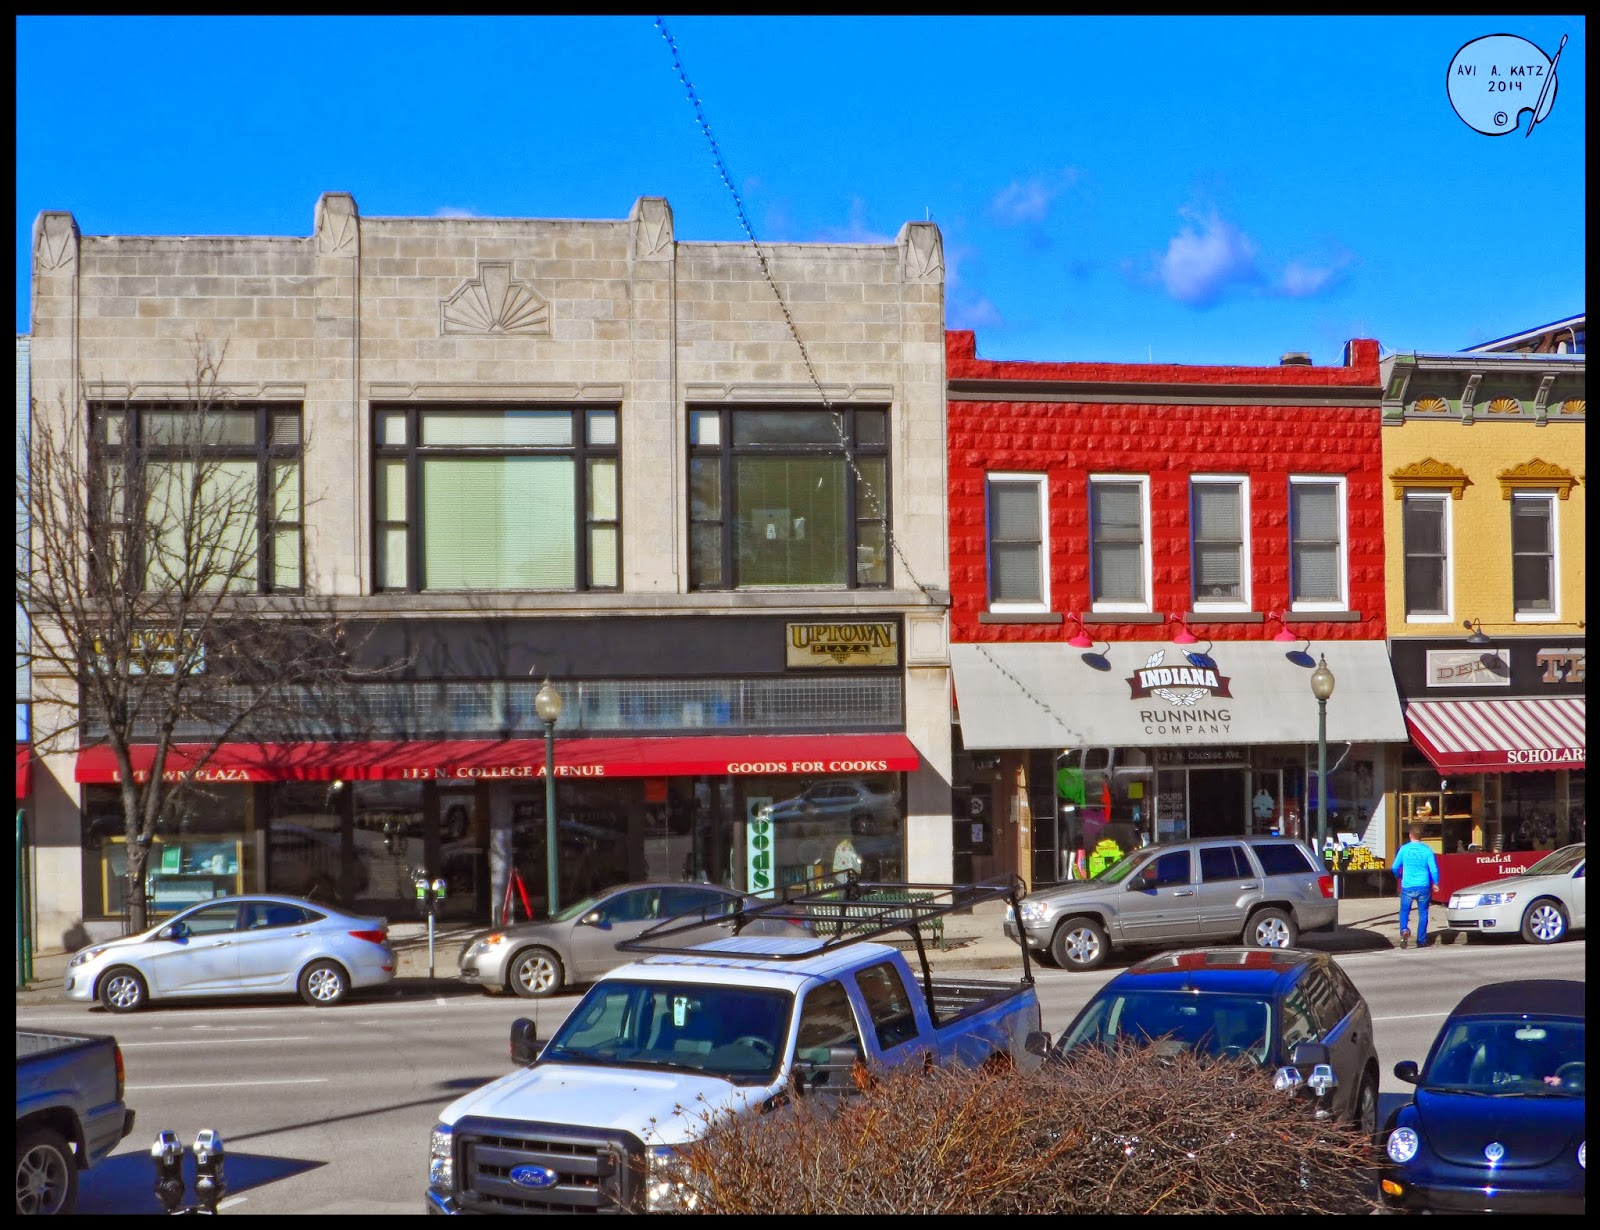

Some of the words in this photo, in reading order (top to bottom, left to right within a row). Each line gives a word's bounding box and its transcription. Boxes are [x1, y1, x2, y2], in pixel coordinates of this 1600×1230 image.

[790, 624, 893, 649] UPTOWN
[814, 645, 868, 653] PLAZA
[1139, 668, 1219, 688] INDIANA
[1140, 710, 1231, 722] RUNNING
[1145, 724, 1230, 735] COMPANY
[1507, 749, 1586, 764] SCHOLAR
[402, 768, 429, 779] 115
[434, 768, 451, 778] N.
[456, 766, 533, 778] COLLEGE
[727, 762, 787, 774] GOODS
[792, 761, 826, 773] FOR
[829, 760, 888, 772] COOKS
[112, 769, 189, 781] UTWN
[195, 769, 250, 781] PLAZA
[1498, 865, 1526, 875] Lunch
[518, 1169, 546, 1184] Ford
